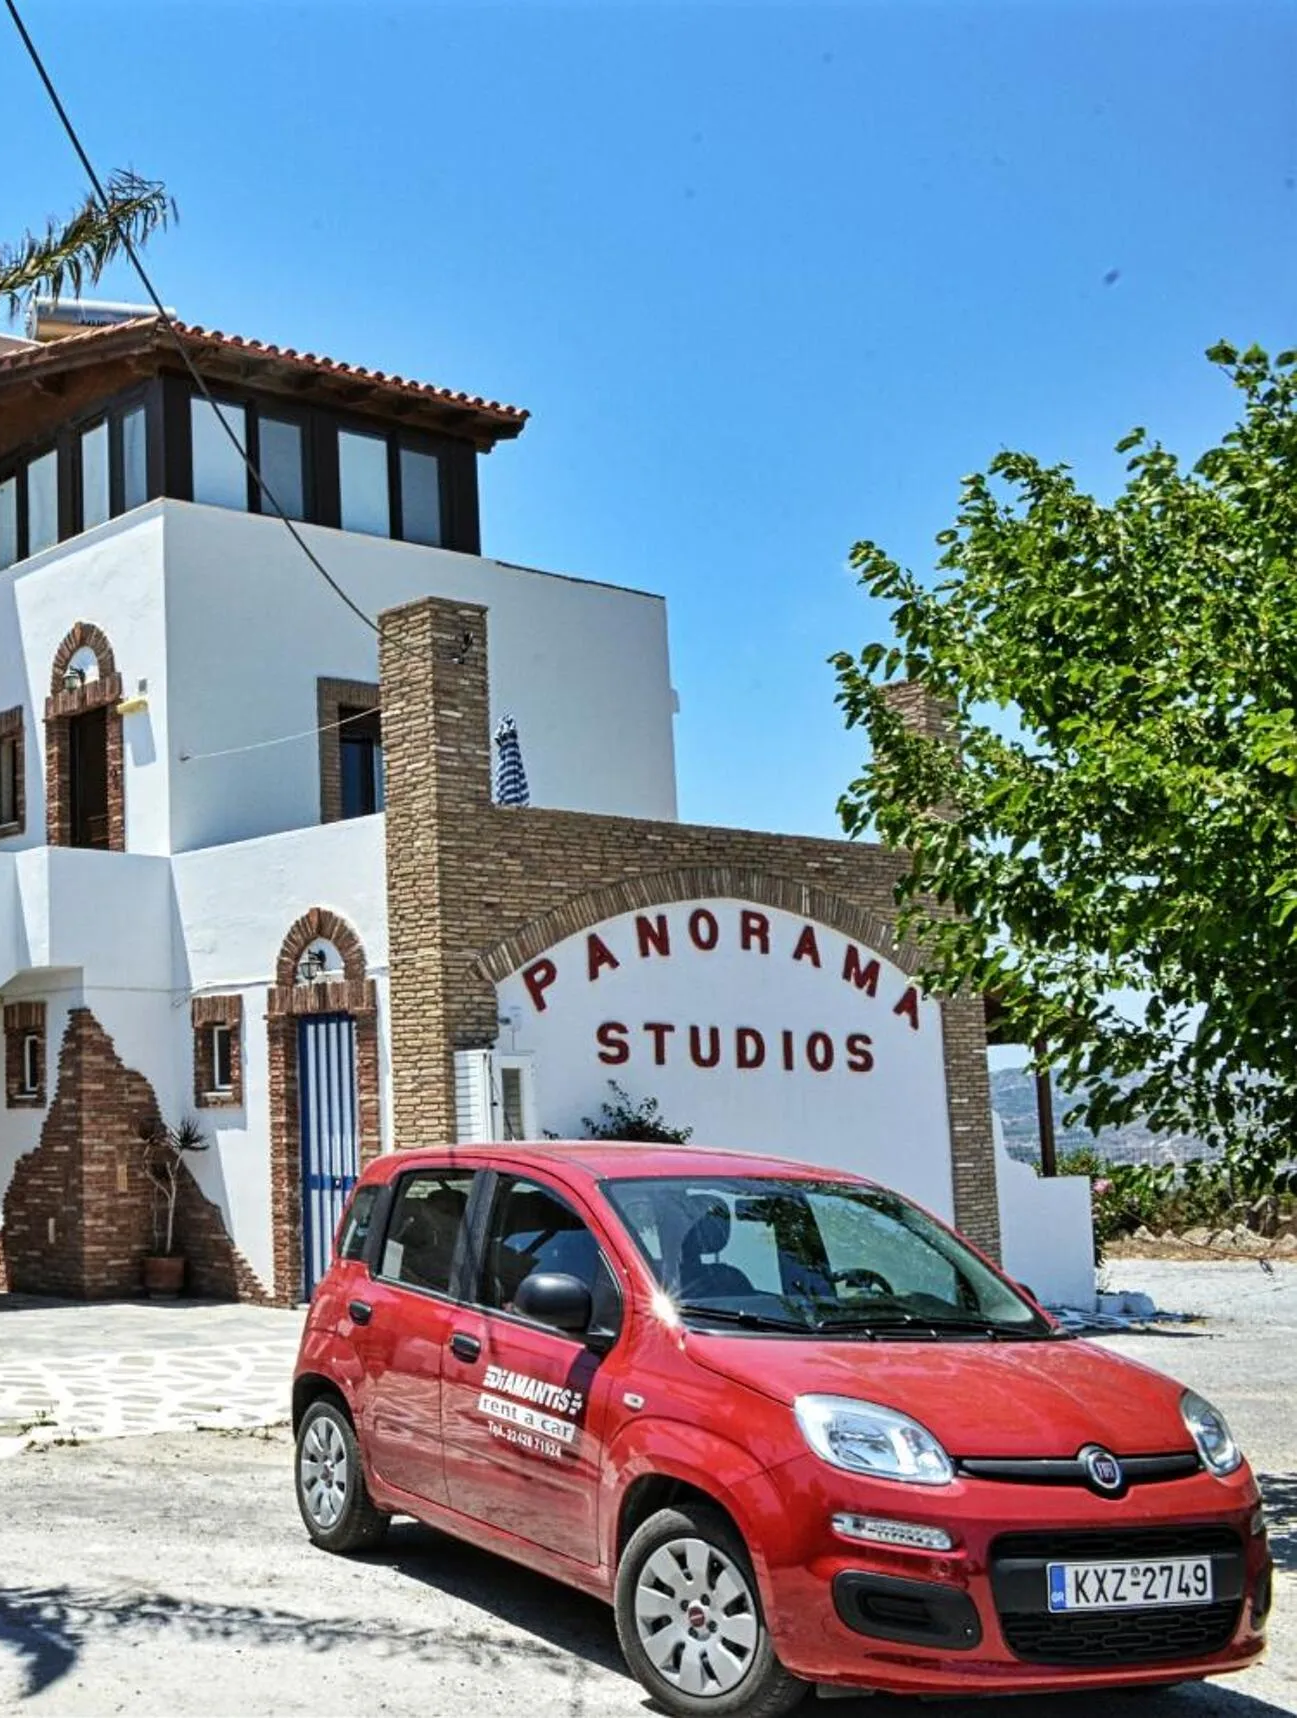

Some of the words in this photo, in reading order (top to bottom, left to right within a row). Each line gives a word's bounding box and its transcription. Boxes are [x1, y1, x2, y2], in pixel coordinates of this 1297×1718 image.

[522, 908, 921, 1030] PANORAMA
[596, 1021, 874, 1073] STUDIOS
[482, 1397, 517, 1420] rent
[524, 1412, 534, 1425] a
[540, 1419, 572, 1438] car
